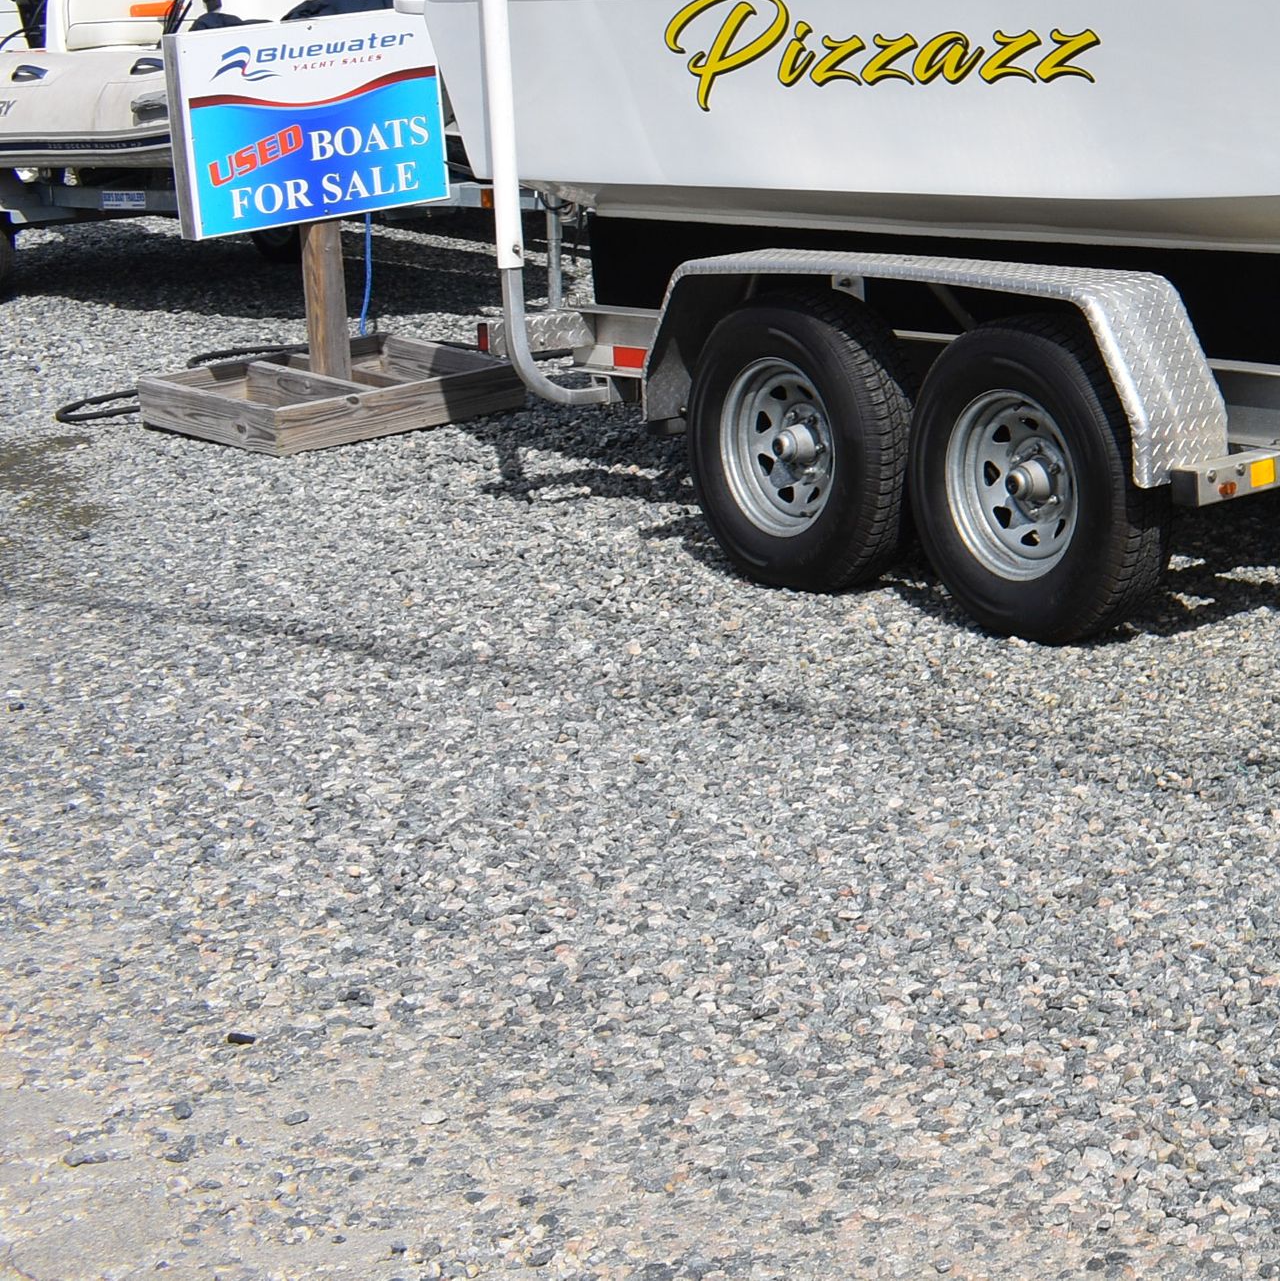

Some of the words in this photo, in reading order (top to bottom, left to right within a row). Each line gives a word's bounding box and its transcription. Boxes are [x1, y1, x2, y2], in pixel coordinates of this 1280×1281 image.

[256, 32, 414, 64] Bluewater
[293, 60, 335, 72] YACHT
[342, 54, 383, 65] SALES
[208, 124, 304, 187] USED
[308, 116, 429, 161] BOATS
[230, 179, 314, 219] FOR
[321, 161, 420, 205] SALE
